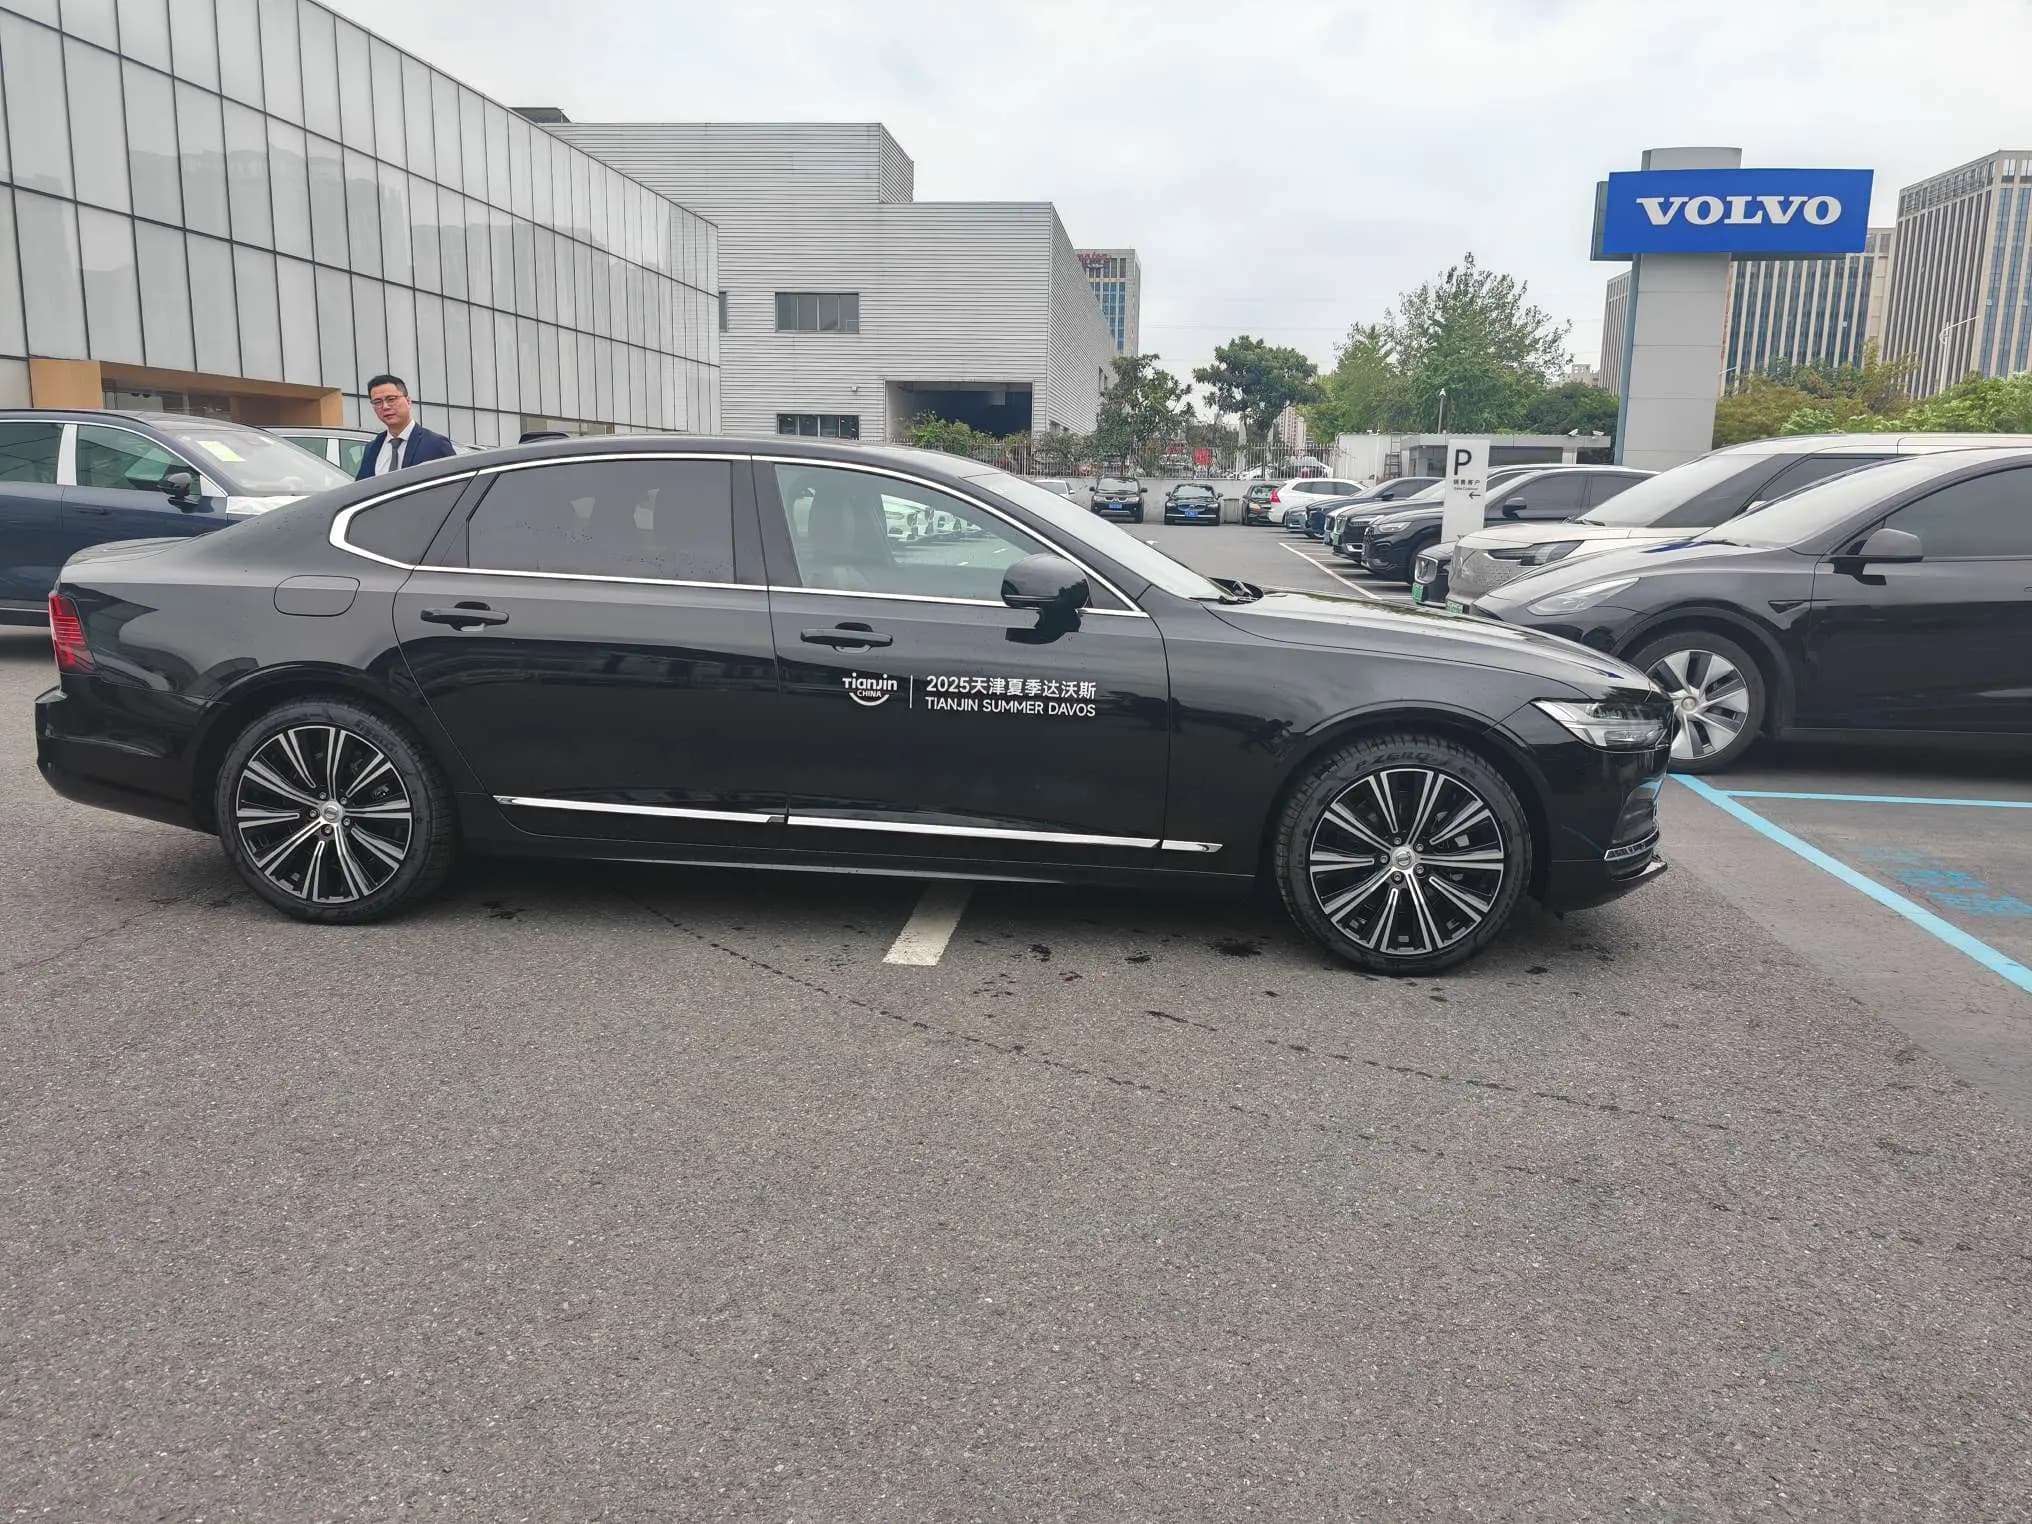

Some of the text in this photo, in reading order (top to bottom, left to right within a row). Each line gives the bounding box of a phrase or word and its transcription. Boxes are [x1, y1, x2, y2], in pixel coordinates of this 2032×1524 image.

[1636, 195, 1842, 225] VOLVO
[1454, 449, 1472, 476] P
[926, 676, 1097, 699] 2025天津夏季达沃斯
[925, 697, 1096, 717] TIANJIN SUMMER DAVOS
